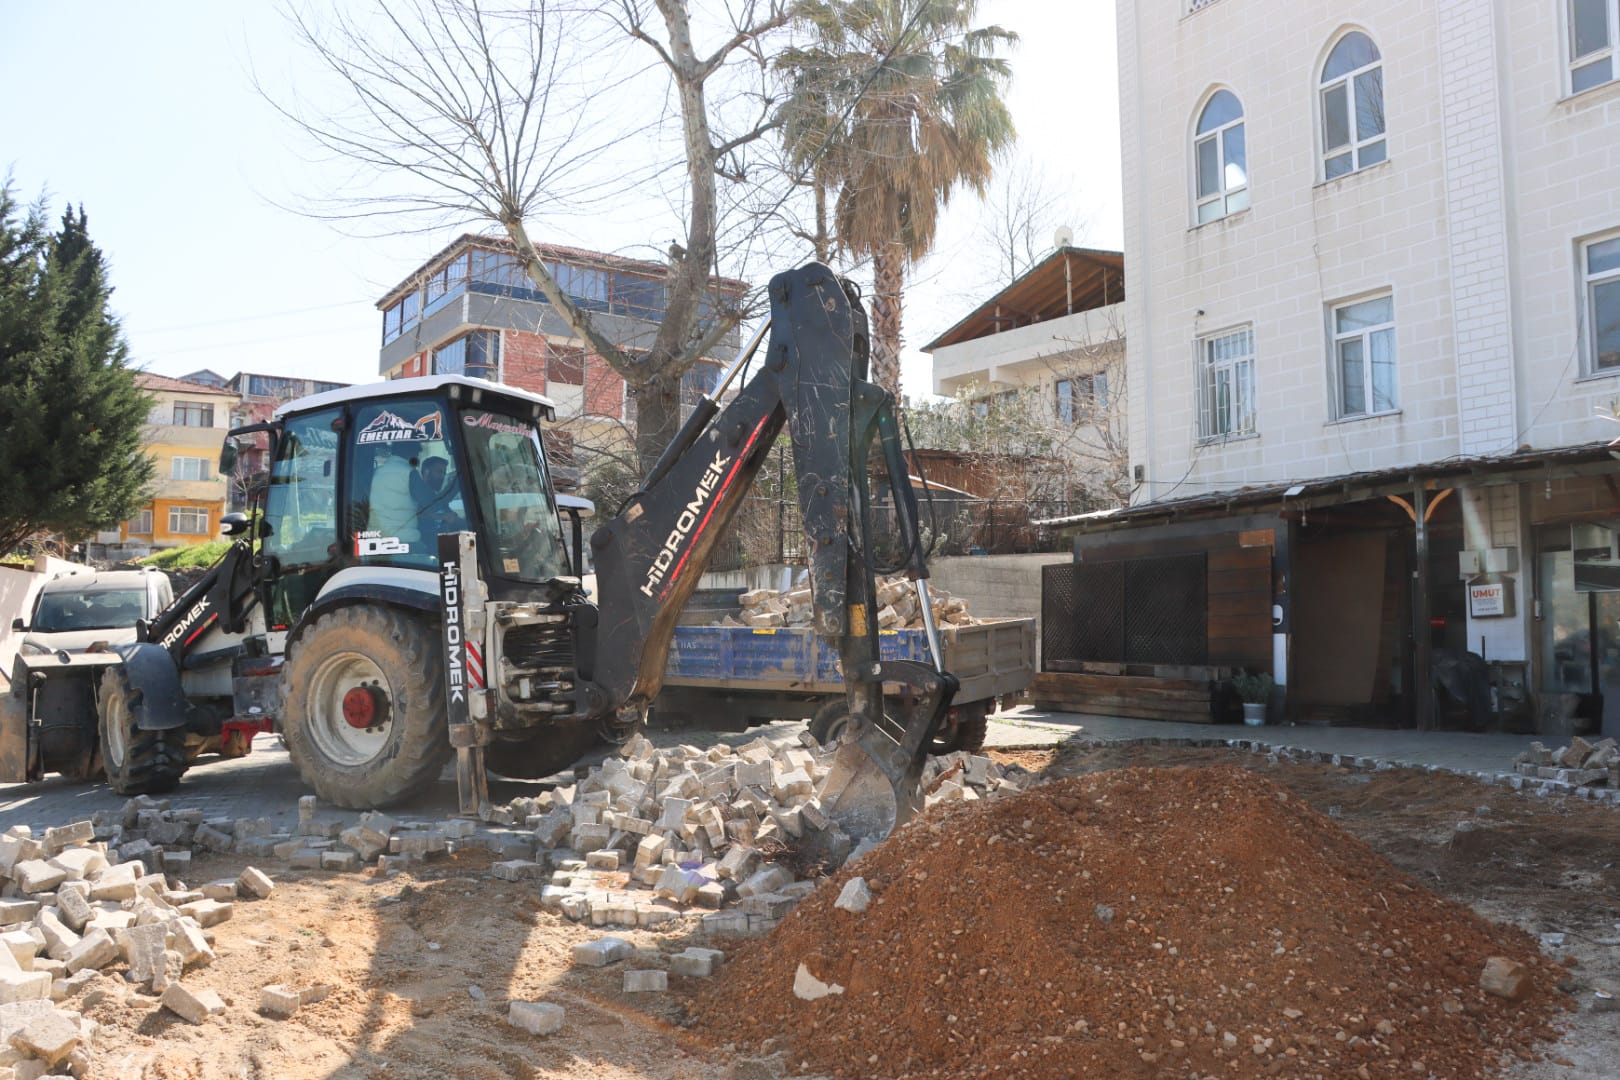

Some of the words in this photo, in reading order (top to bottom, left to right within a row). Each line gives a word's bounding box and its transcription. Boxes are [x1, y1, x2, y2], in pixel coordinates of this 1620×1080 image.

[360, 430, 412, 443] EMEKTAR
[358, 530, 382, 538] HMK
[1472, 588, 1501, 599] UMUT
